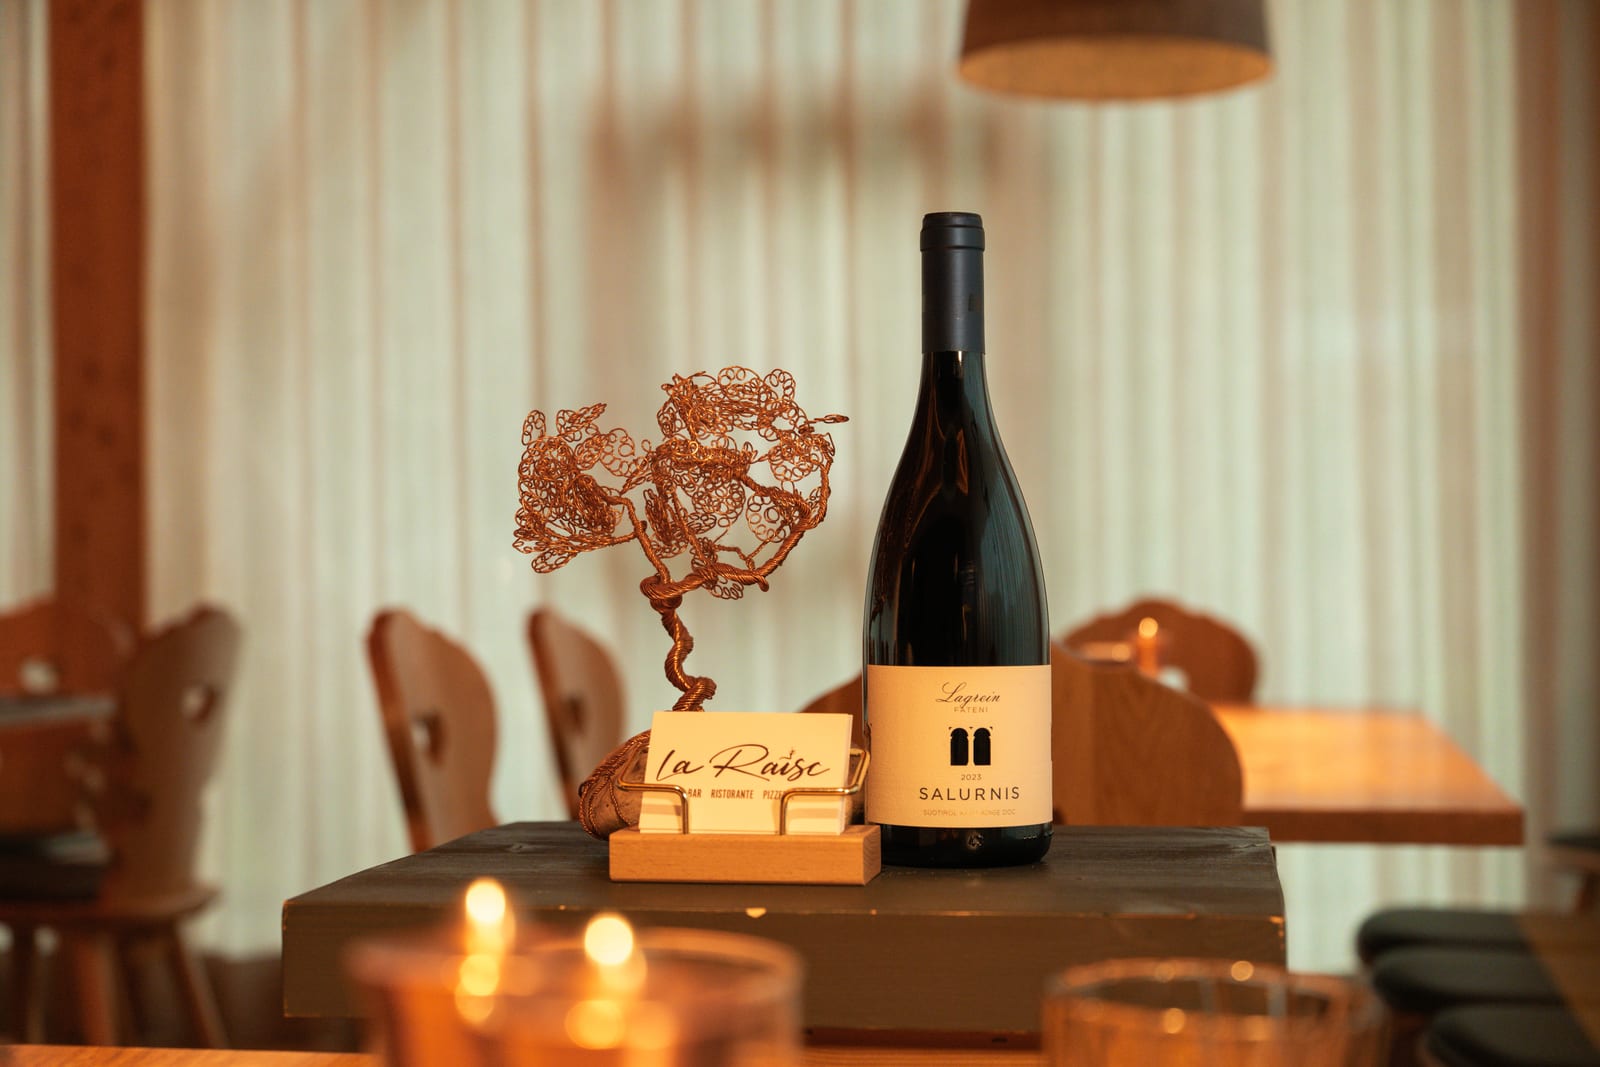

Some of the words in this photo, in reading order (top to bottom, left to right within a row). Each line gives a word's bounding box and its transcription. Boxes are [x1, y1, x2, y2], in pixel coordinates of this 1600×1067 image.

[936, 682, 1001, 708] Lagrein
[954, 706, 989, 714] FATENI
[655, 749, 705, 782] La
[961, 773, 983, 781] 2023
[688, 788, 702, 798] BAR
[710, 788, 754, 800] RISTORANTE
[919, 786, 1020, 801] SALURNIS
